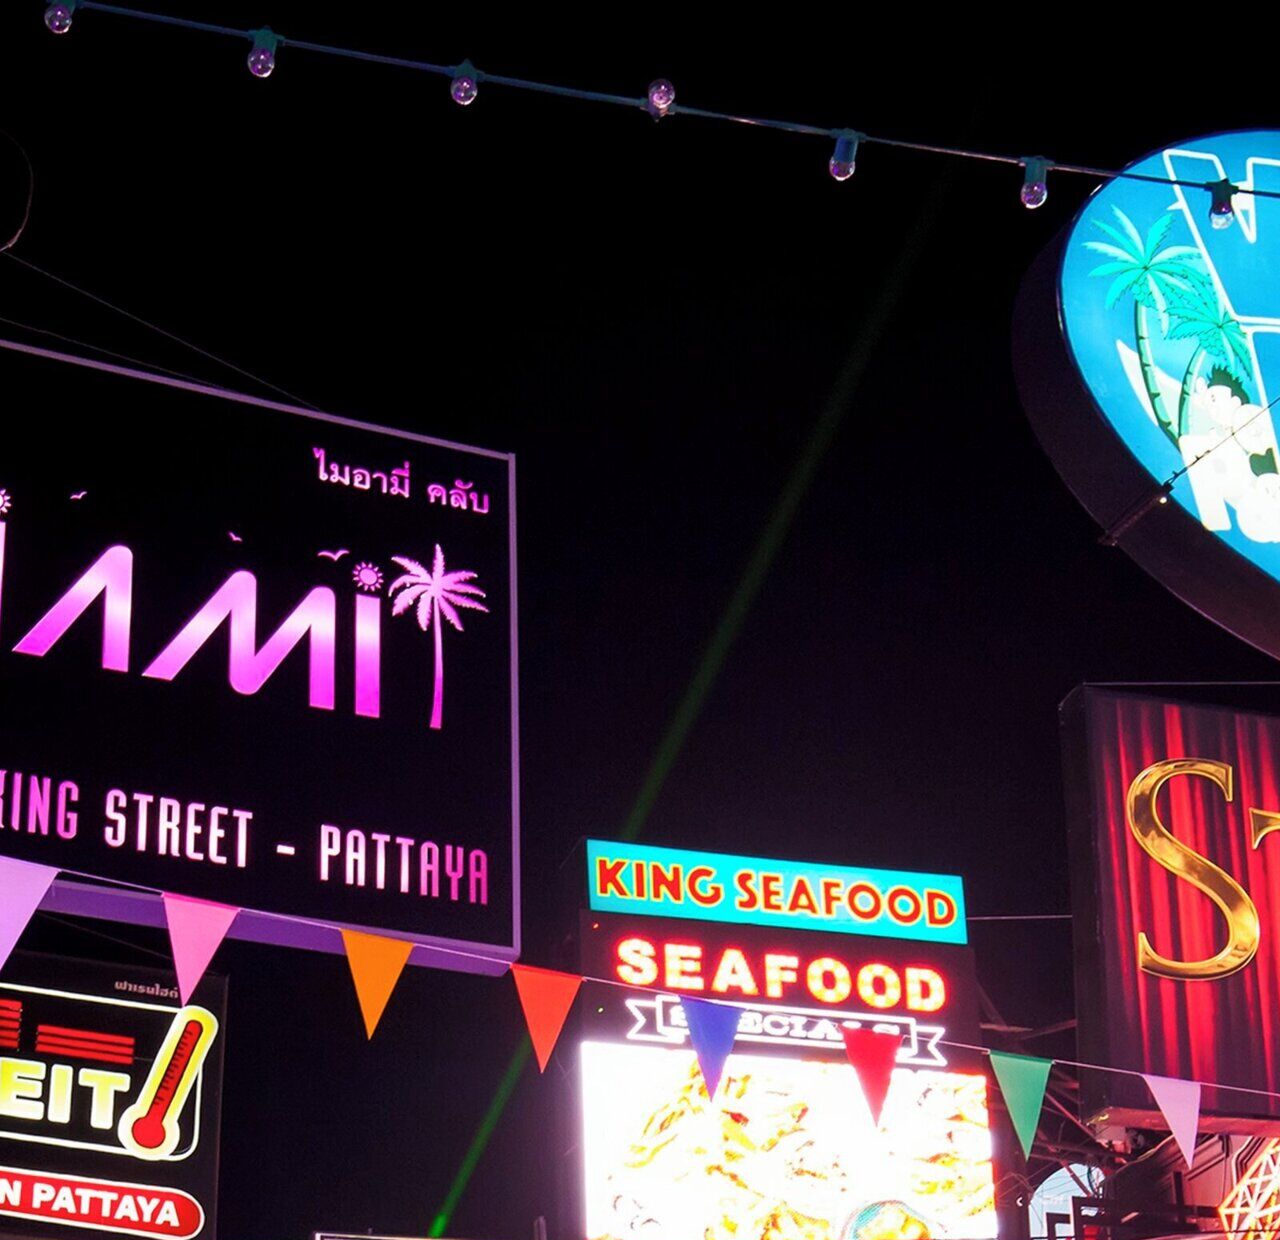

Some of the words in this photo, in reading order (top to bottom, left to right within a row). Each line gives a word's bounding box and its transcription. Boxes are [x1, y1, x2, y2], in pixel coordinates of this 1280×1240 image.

[314, 448, 411, 500] ไมอามี่
[428, 463, 490, 514] คลับ
[105, 790, 253, 868] STREET
[320, 824, 489, 905] PATTAYA
[596, 856, 721, 905] KING
[736, 871, 958, 928] SEAFOOD
[616, 936, 947, 1012] SEAFOOD
[32, 1180, 180, 1227] PATTAYA
